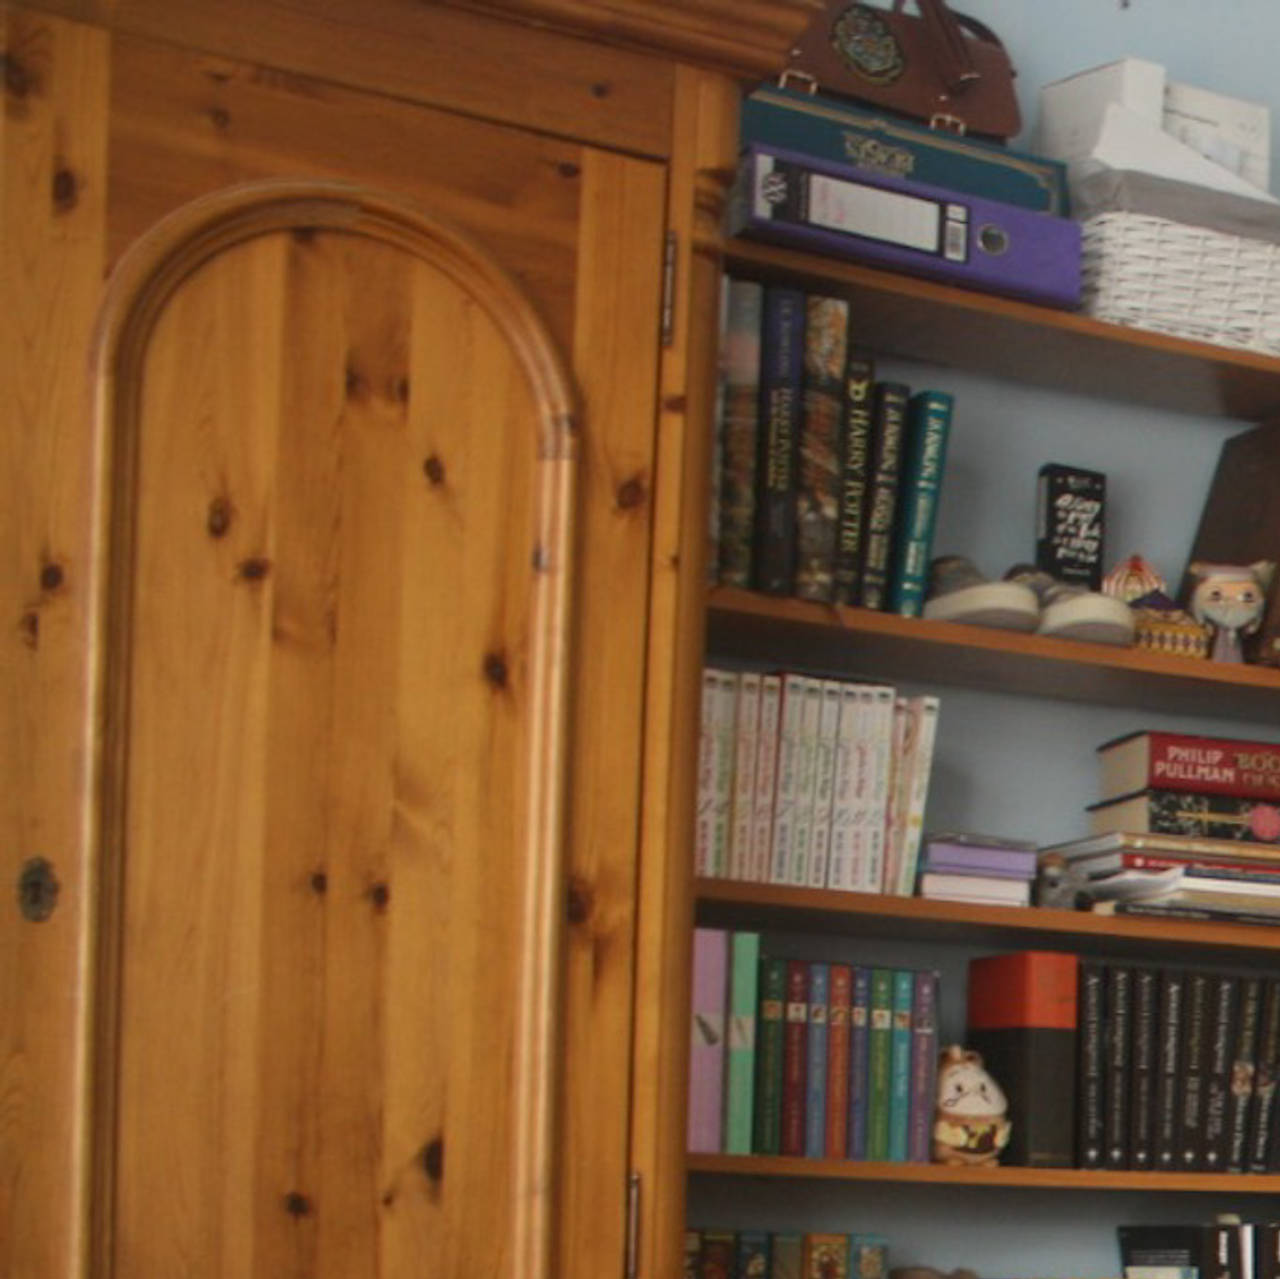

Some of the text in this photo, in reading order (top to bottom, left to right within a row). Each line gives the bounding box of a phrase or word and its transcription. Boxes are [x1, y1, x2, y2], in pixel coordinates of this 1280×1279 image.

[840, 409, 869, 552] HARRY POTTER
[1166, 745, 1223, 764] PHILIP
[1154, 761, 1236, 783] PULLMAN
